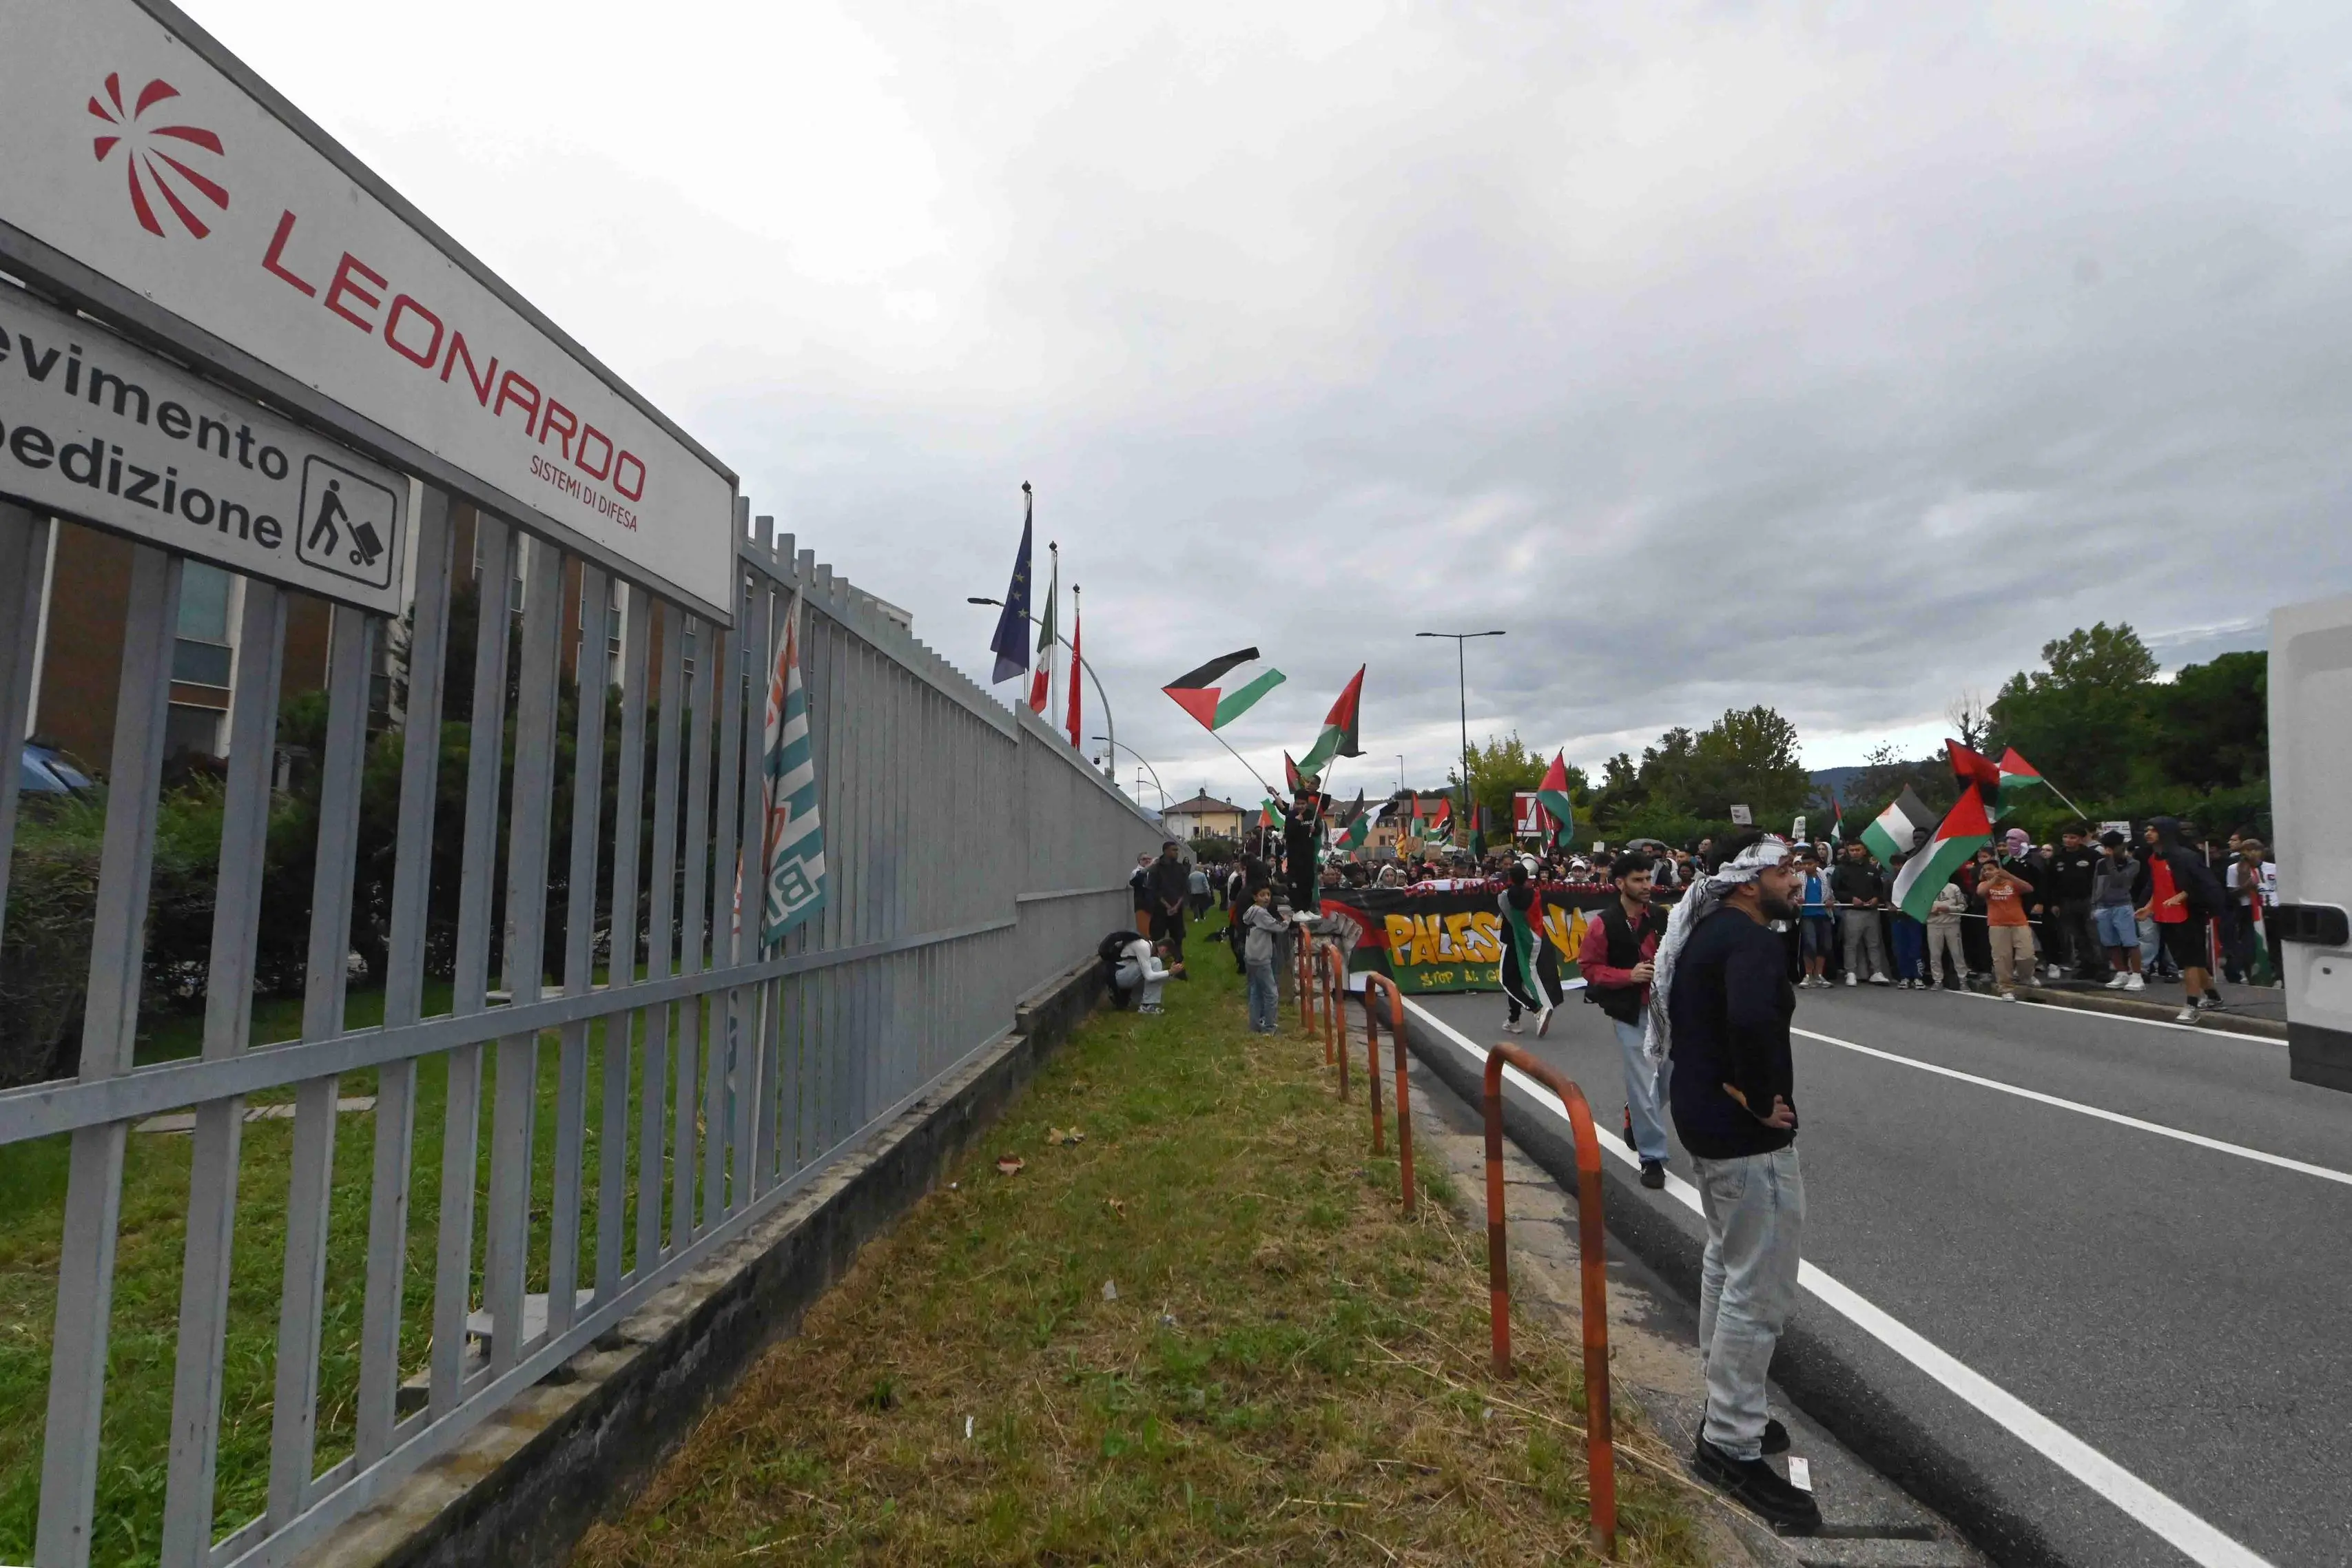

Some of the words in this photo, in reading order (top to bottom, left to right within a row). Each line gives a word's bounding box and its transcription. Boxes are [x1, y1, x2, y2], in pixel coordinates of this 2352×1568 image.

[0, 325, 289, 481] vimento
[262, 209, 646, 502] LEONARDO
[0, 418, 282, 549] edizione
[530, 454, 581, 499] SISTEMI
[583, 486, 597, 508] DI
[598, 495, 637, 533] DIFESA
